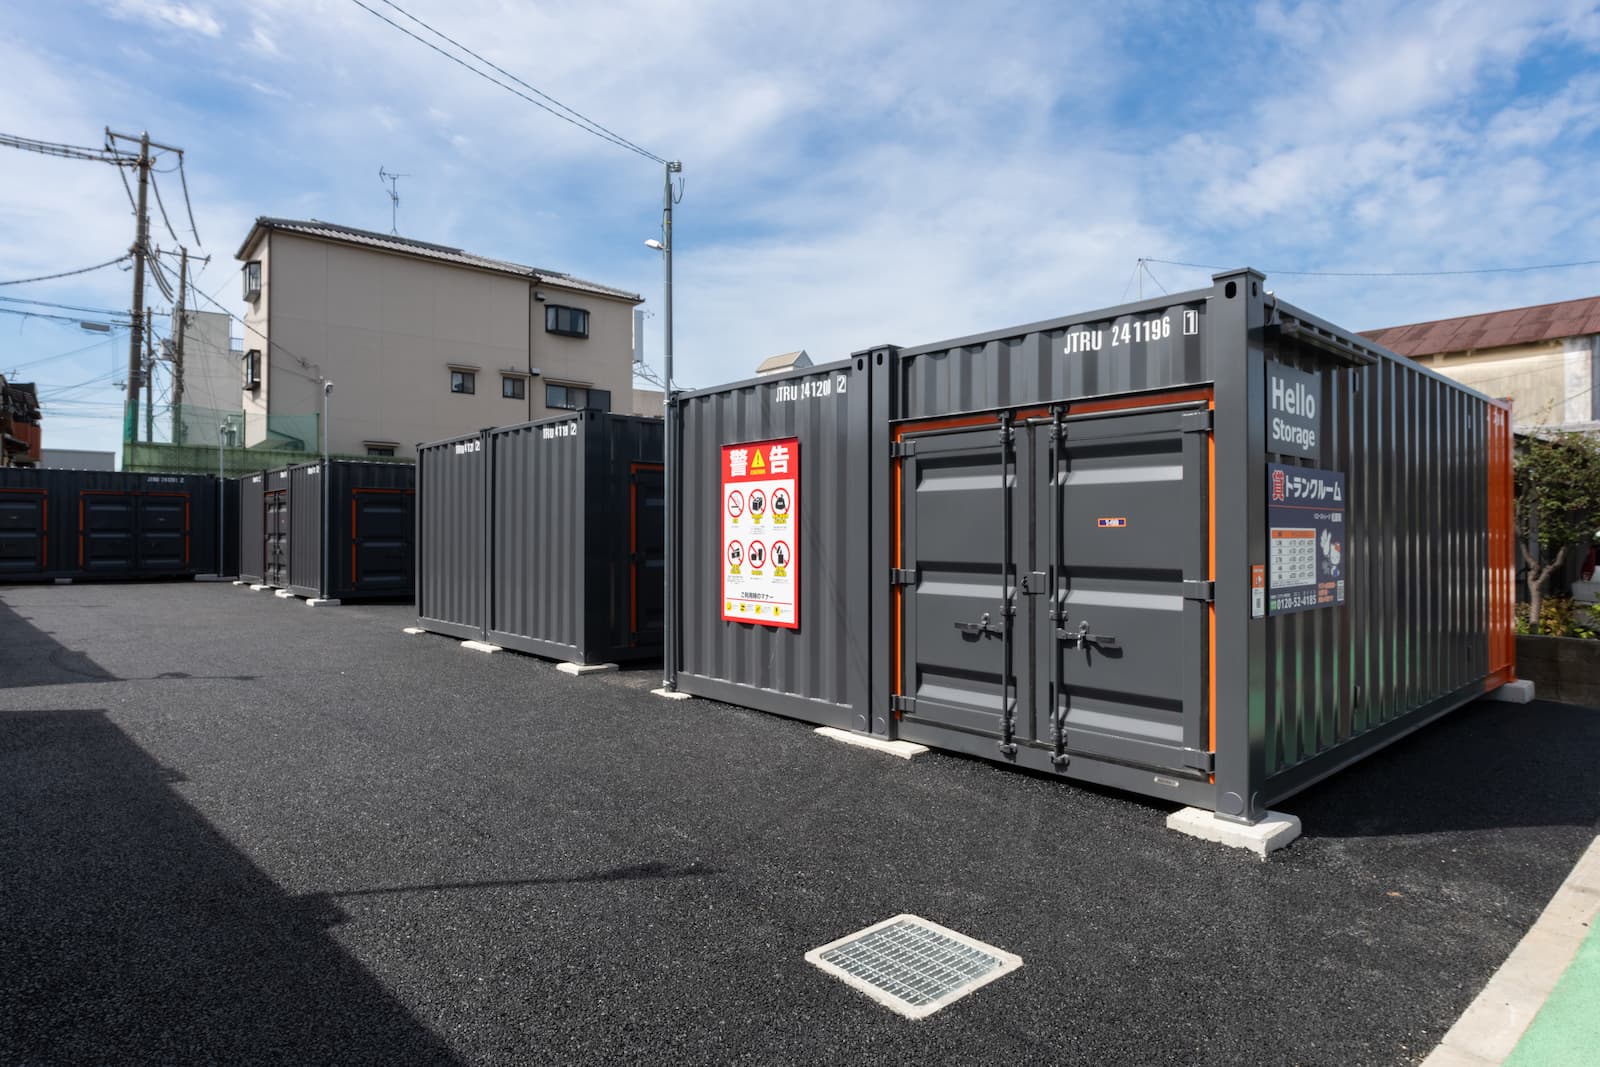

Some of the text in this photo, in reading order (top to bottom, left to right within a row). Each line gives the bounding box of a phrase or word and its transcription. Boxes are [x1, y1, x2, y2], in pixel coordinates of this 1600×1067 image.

[1064, 330, 1103, 355] JTRU
[1111, 316, 1171, 347] 241196
[837, 375, 846, 393] 2
[1271, 376, 1316, 419] Hello
[1272, 417, 1316, 451] Storage
[1272, 470, 1342, 501] 貸トランクルーム
